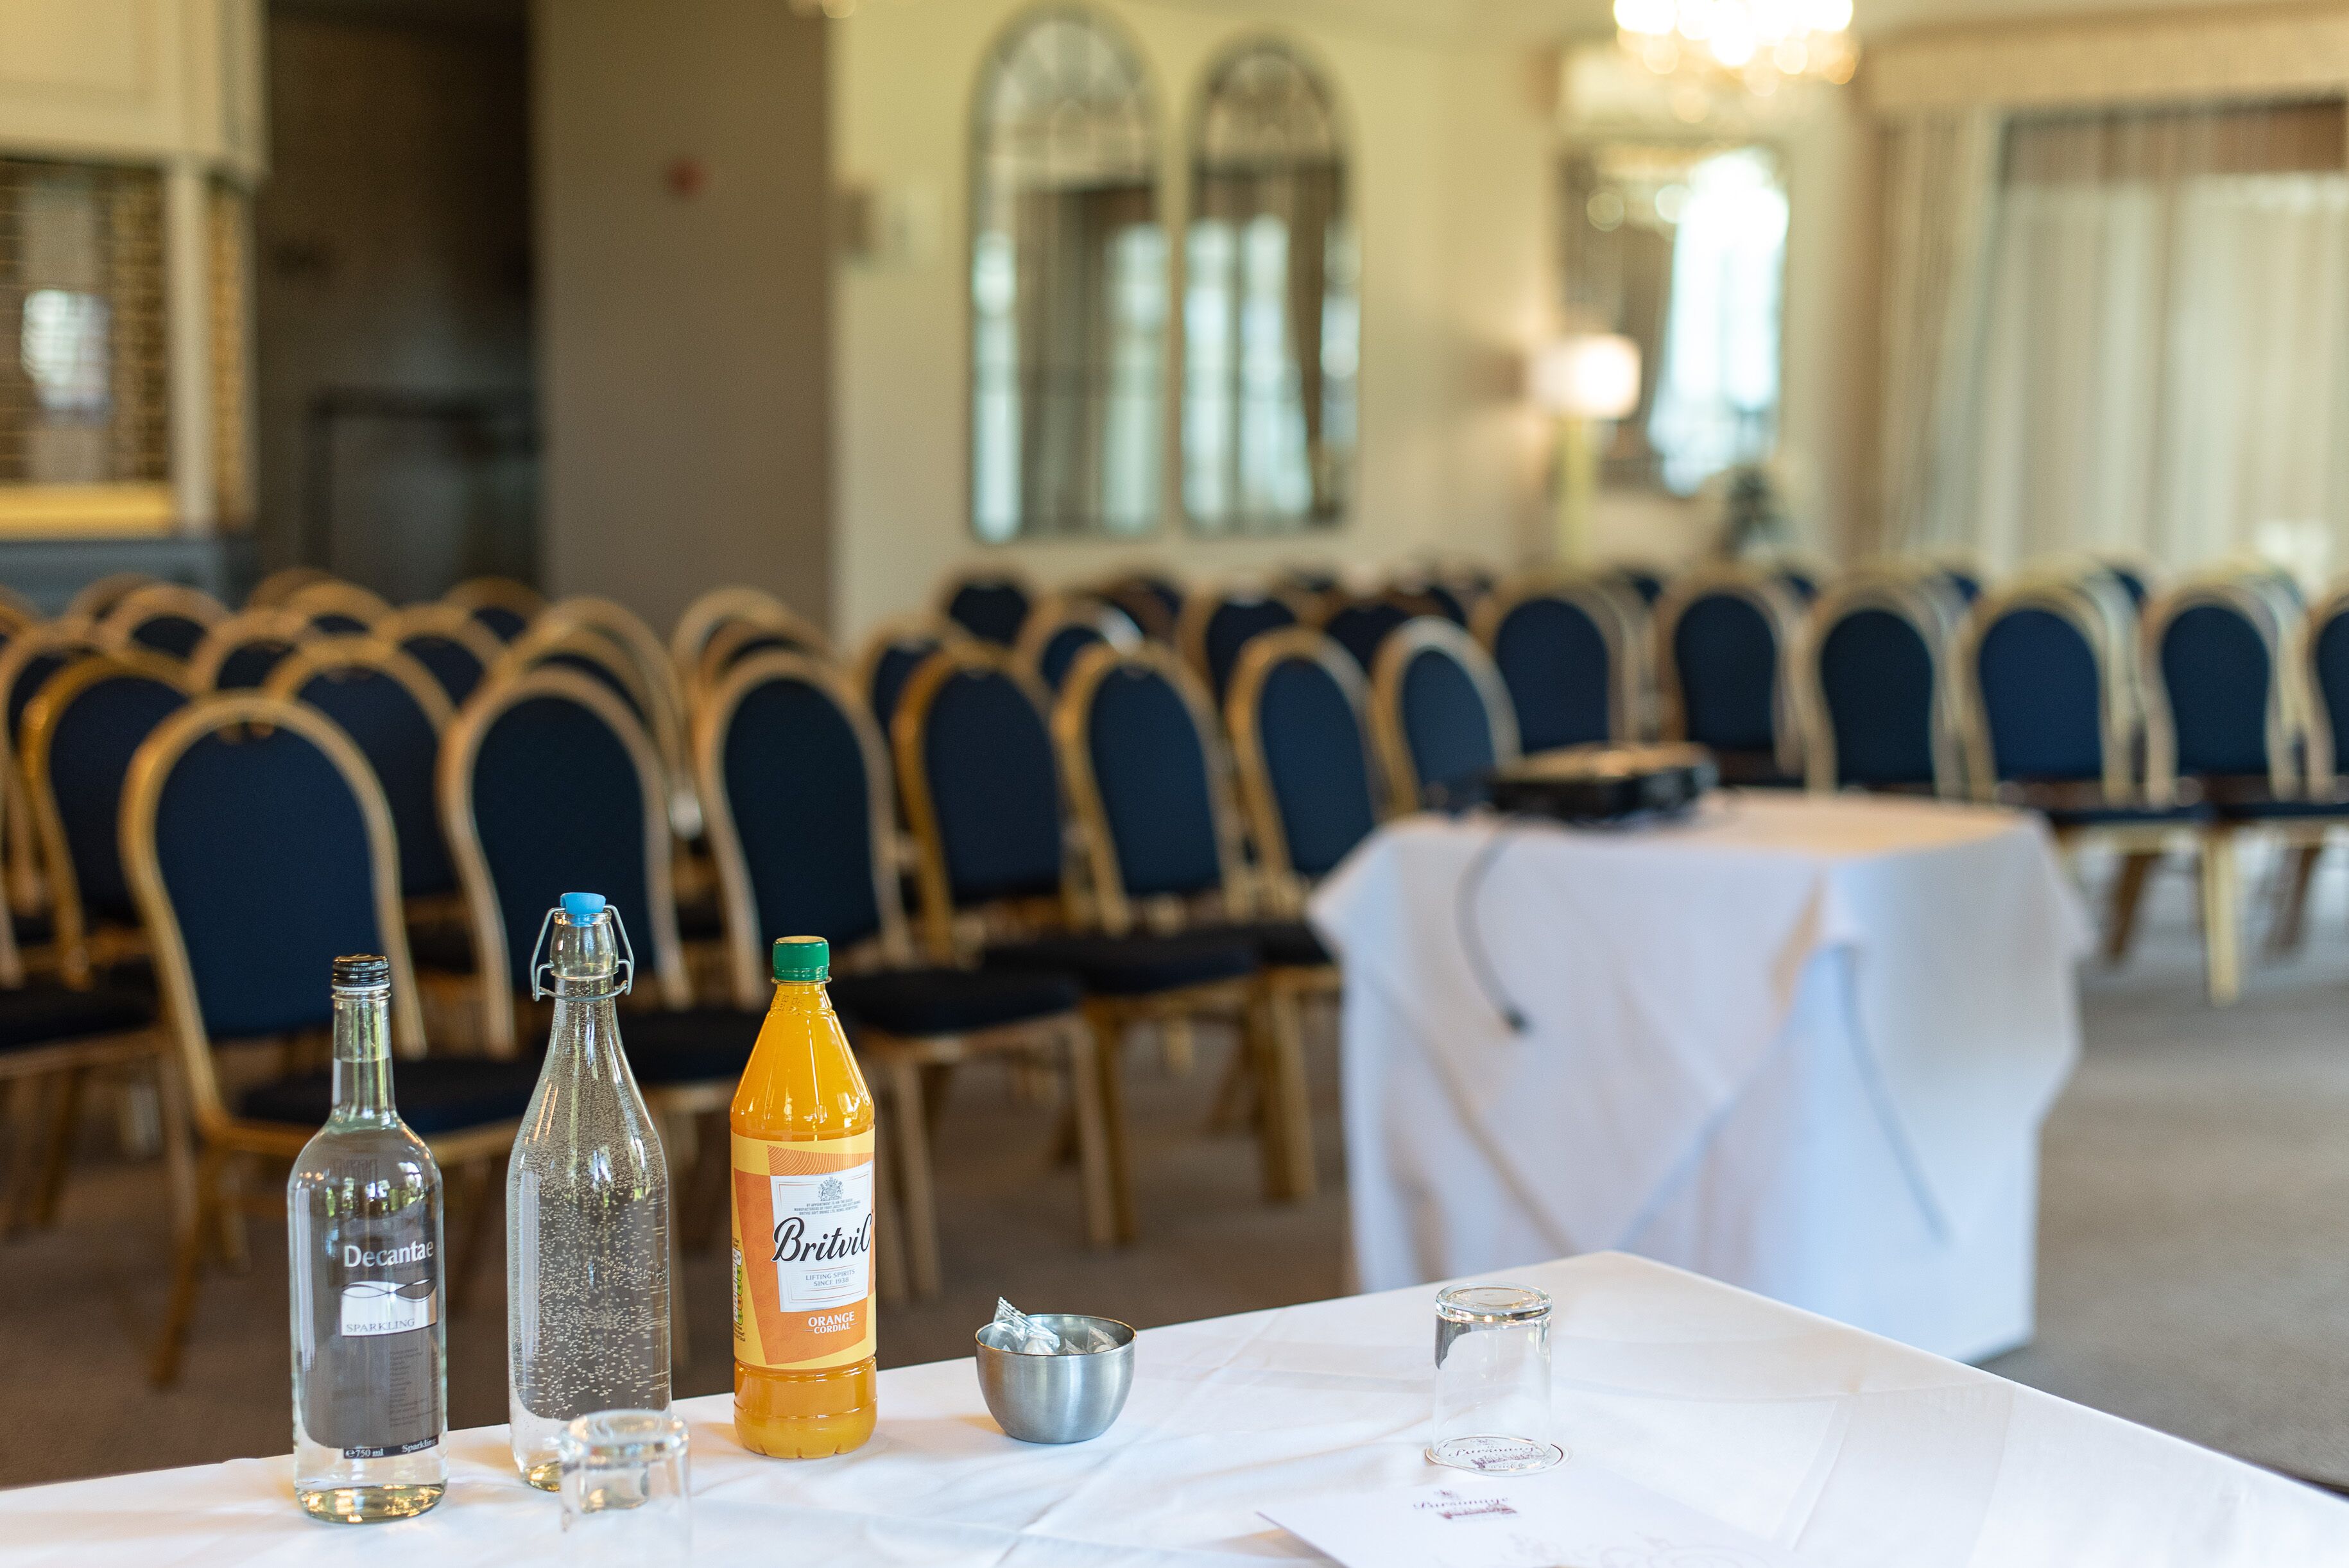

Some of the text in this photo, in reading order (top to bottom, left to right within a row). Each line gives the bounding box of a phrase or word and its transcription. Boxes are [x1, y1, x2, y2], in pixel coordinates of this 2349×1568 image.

[343, 1240, 434, 1268] Decantae
[833, 1269, 856, 1278] SPIRITS
[346, 1318, 415, 1332] SPARKLING
[807, 1311, 855, 1327] ORANGE
[814, 1322, 851, 1334] CORDIAL
[372, 1448, 384, 1457] ml
